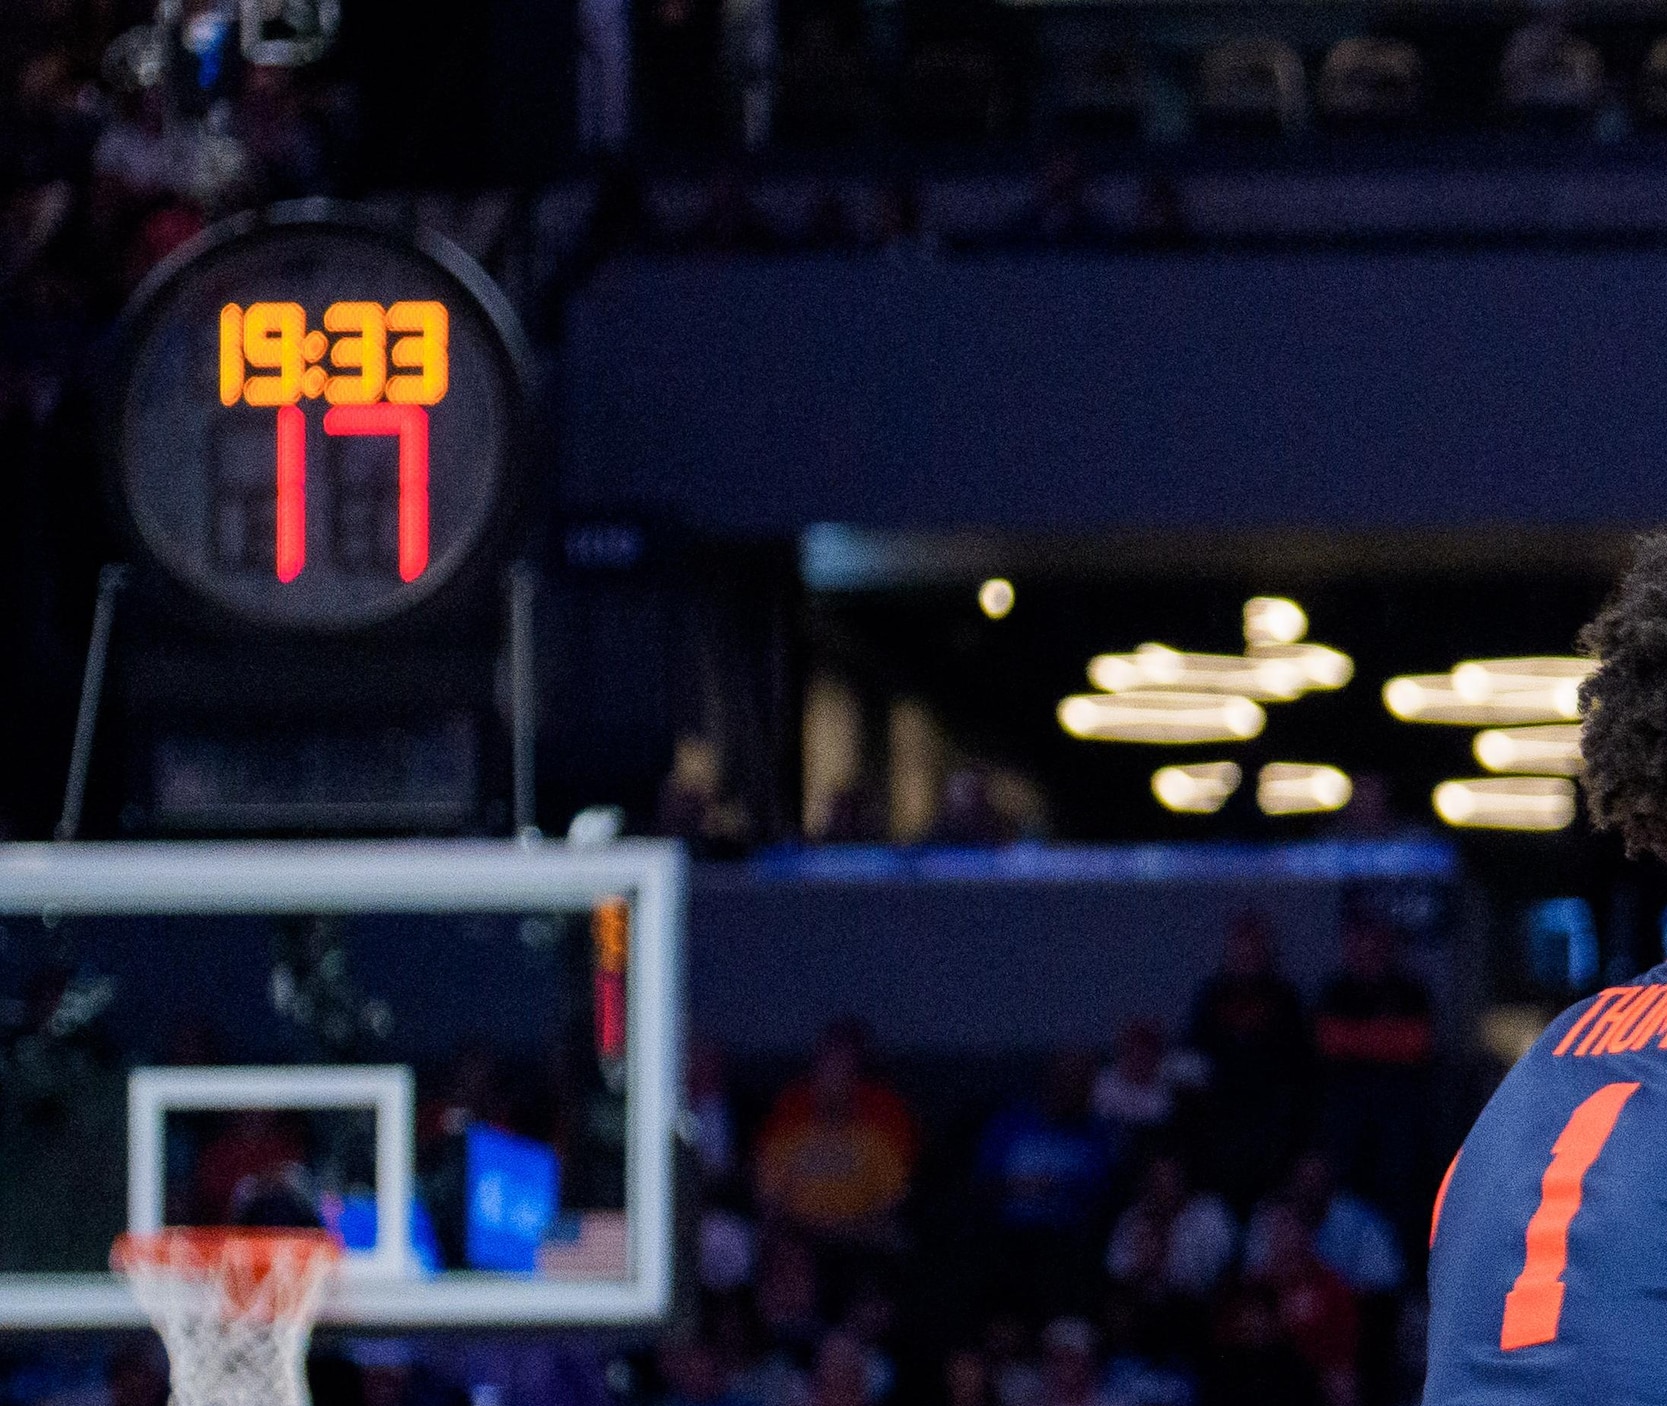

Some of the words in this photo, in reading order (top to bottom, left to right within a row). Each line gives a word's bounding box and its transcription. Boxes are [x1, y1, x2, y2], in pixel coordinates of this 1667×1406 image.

[219, 300, 450, 408] 19:33
[276, 403, 431, 583] 17
[1500, 1081, 1642, 1352] 1
